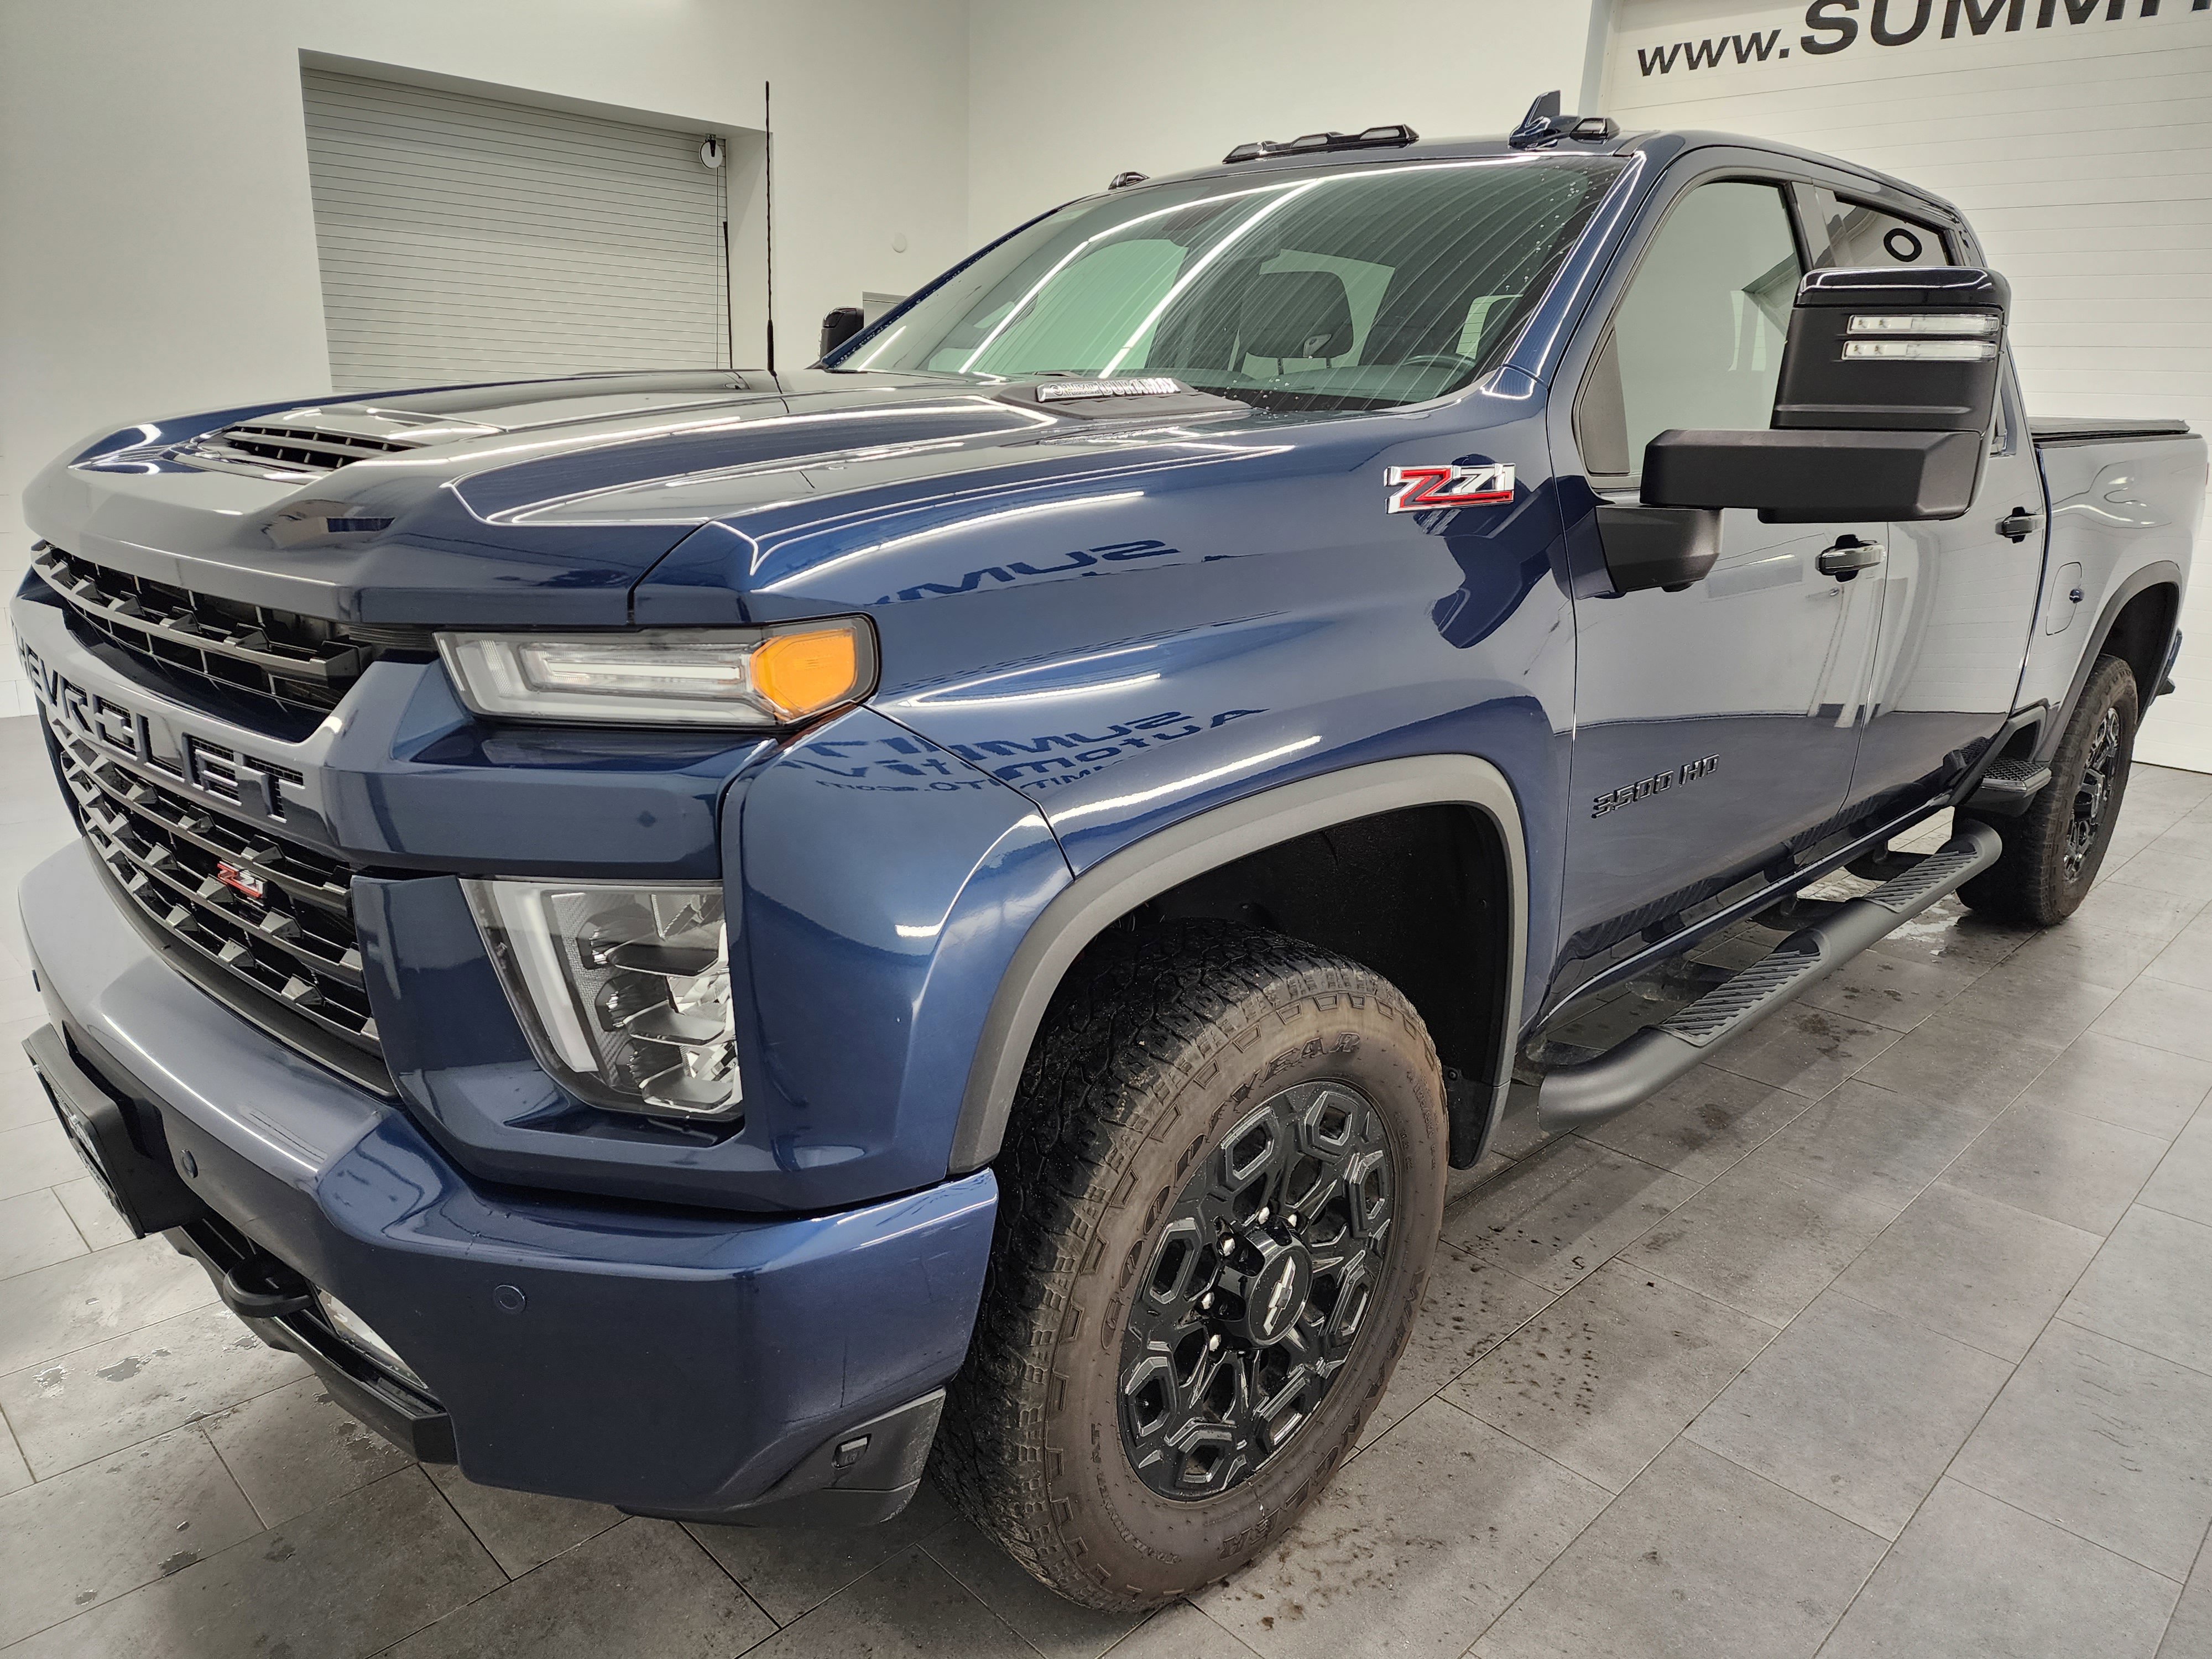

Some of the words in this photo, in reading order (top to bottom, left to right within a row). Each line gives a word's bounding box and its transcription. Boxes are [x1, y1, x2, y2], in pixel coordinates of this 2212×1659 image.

[1637, 0, 2212, 77] www.SUM
[1099, 378, 1181, 397] DURAMAX
[1384, 463, 1516, 514] Z71
[11, 616, 305, 823] HEVROLET
[1590, 770, 1674, 819] 3500
[1677, 753, 1720, 788] HD
